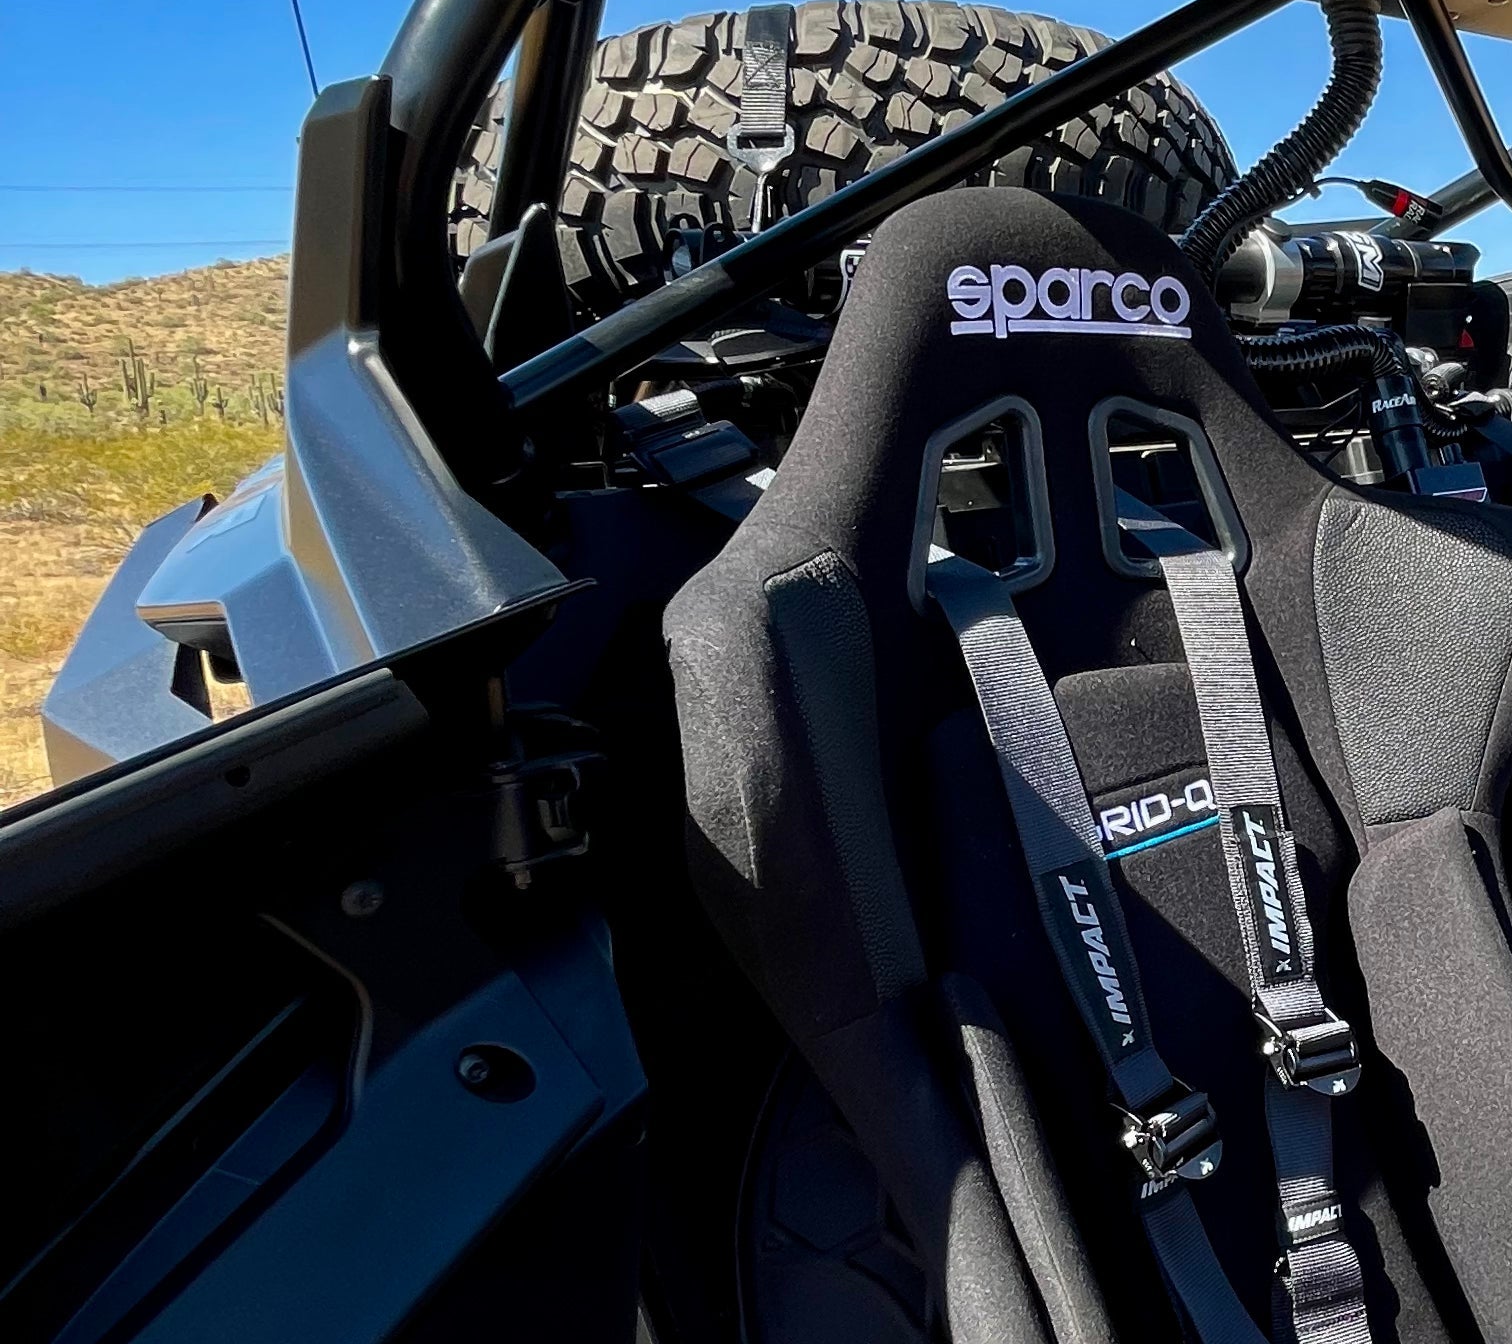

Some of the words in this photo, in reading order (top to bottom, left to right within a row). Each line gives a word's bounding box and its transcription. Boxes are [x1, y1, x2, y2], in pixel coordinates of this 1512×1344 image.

[946, 263, 1192, 339] sparco
[1094, 778, 1218, 841] RID-Q
[1242, 810, 1292, 955] IMPACT
[1058, 874, 1132, 1025] IMPACT
